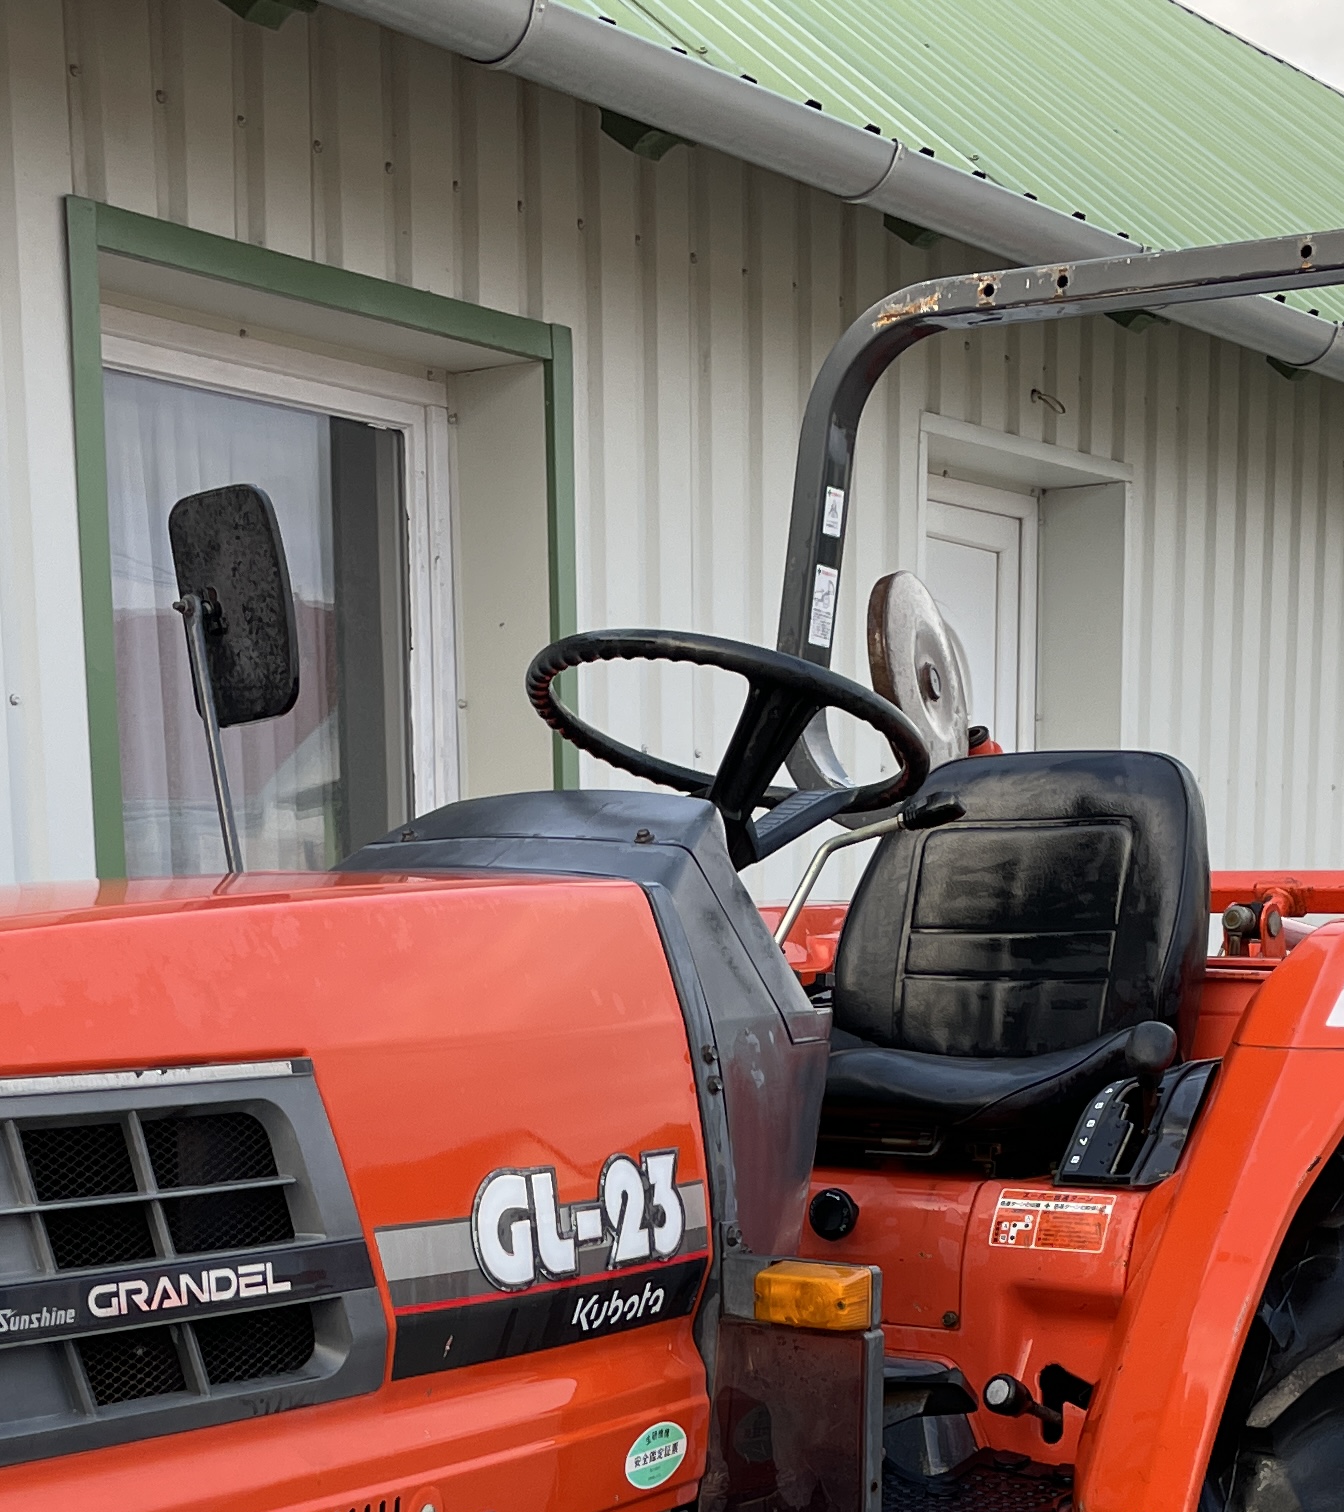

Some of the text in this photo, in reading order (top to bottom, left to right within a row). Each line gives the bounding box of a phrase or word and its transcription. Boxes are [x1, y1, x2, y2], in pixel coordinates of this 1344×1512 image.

[474, 1150, 684, 1288] GL-23
[87, 1261, 292, 1318] GRANDEL
[571, 1281, 665, 1331] Kubota
